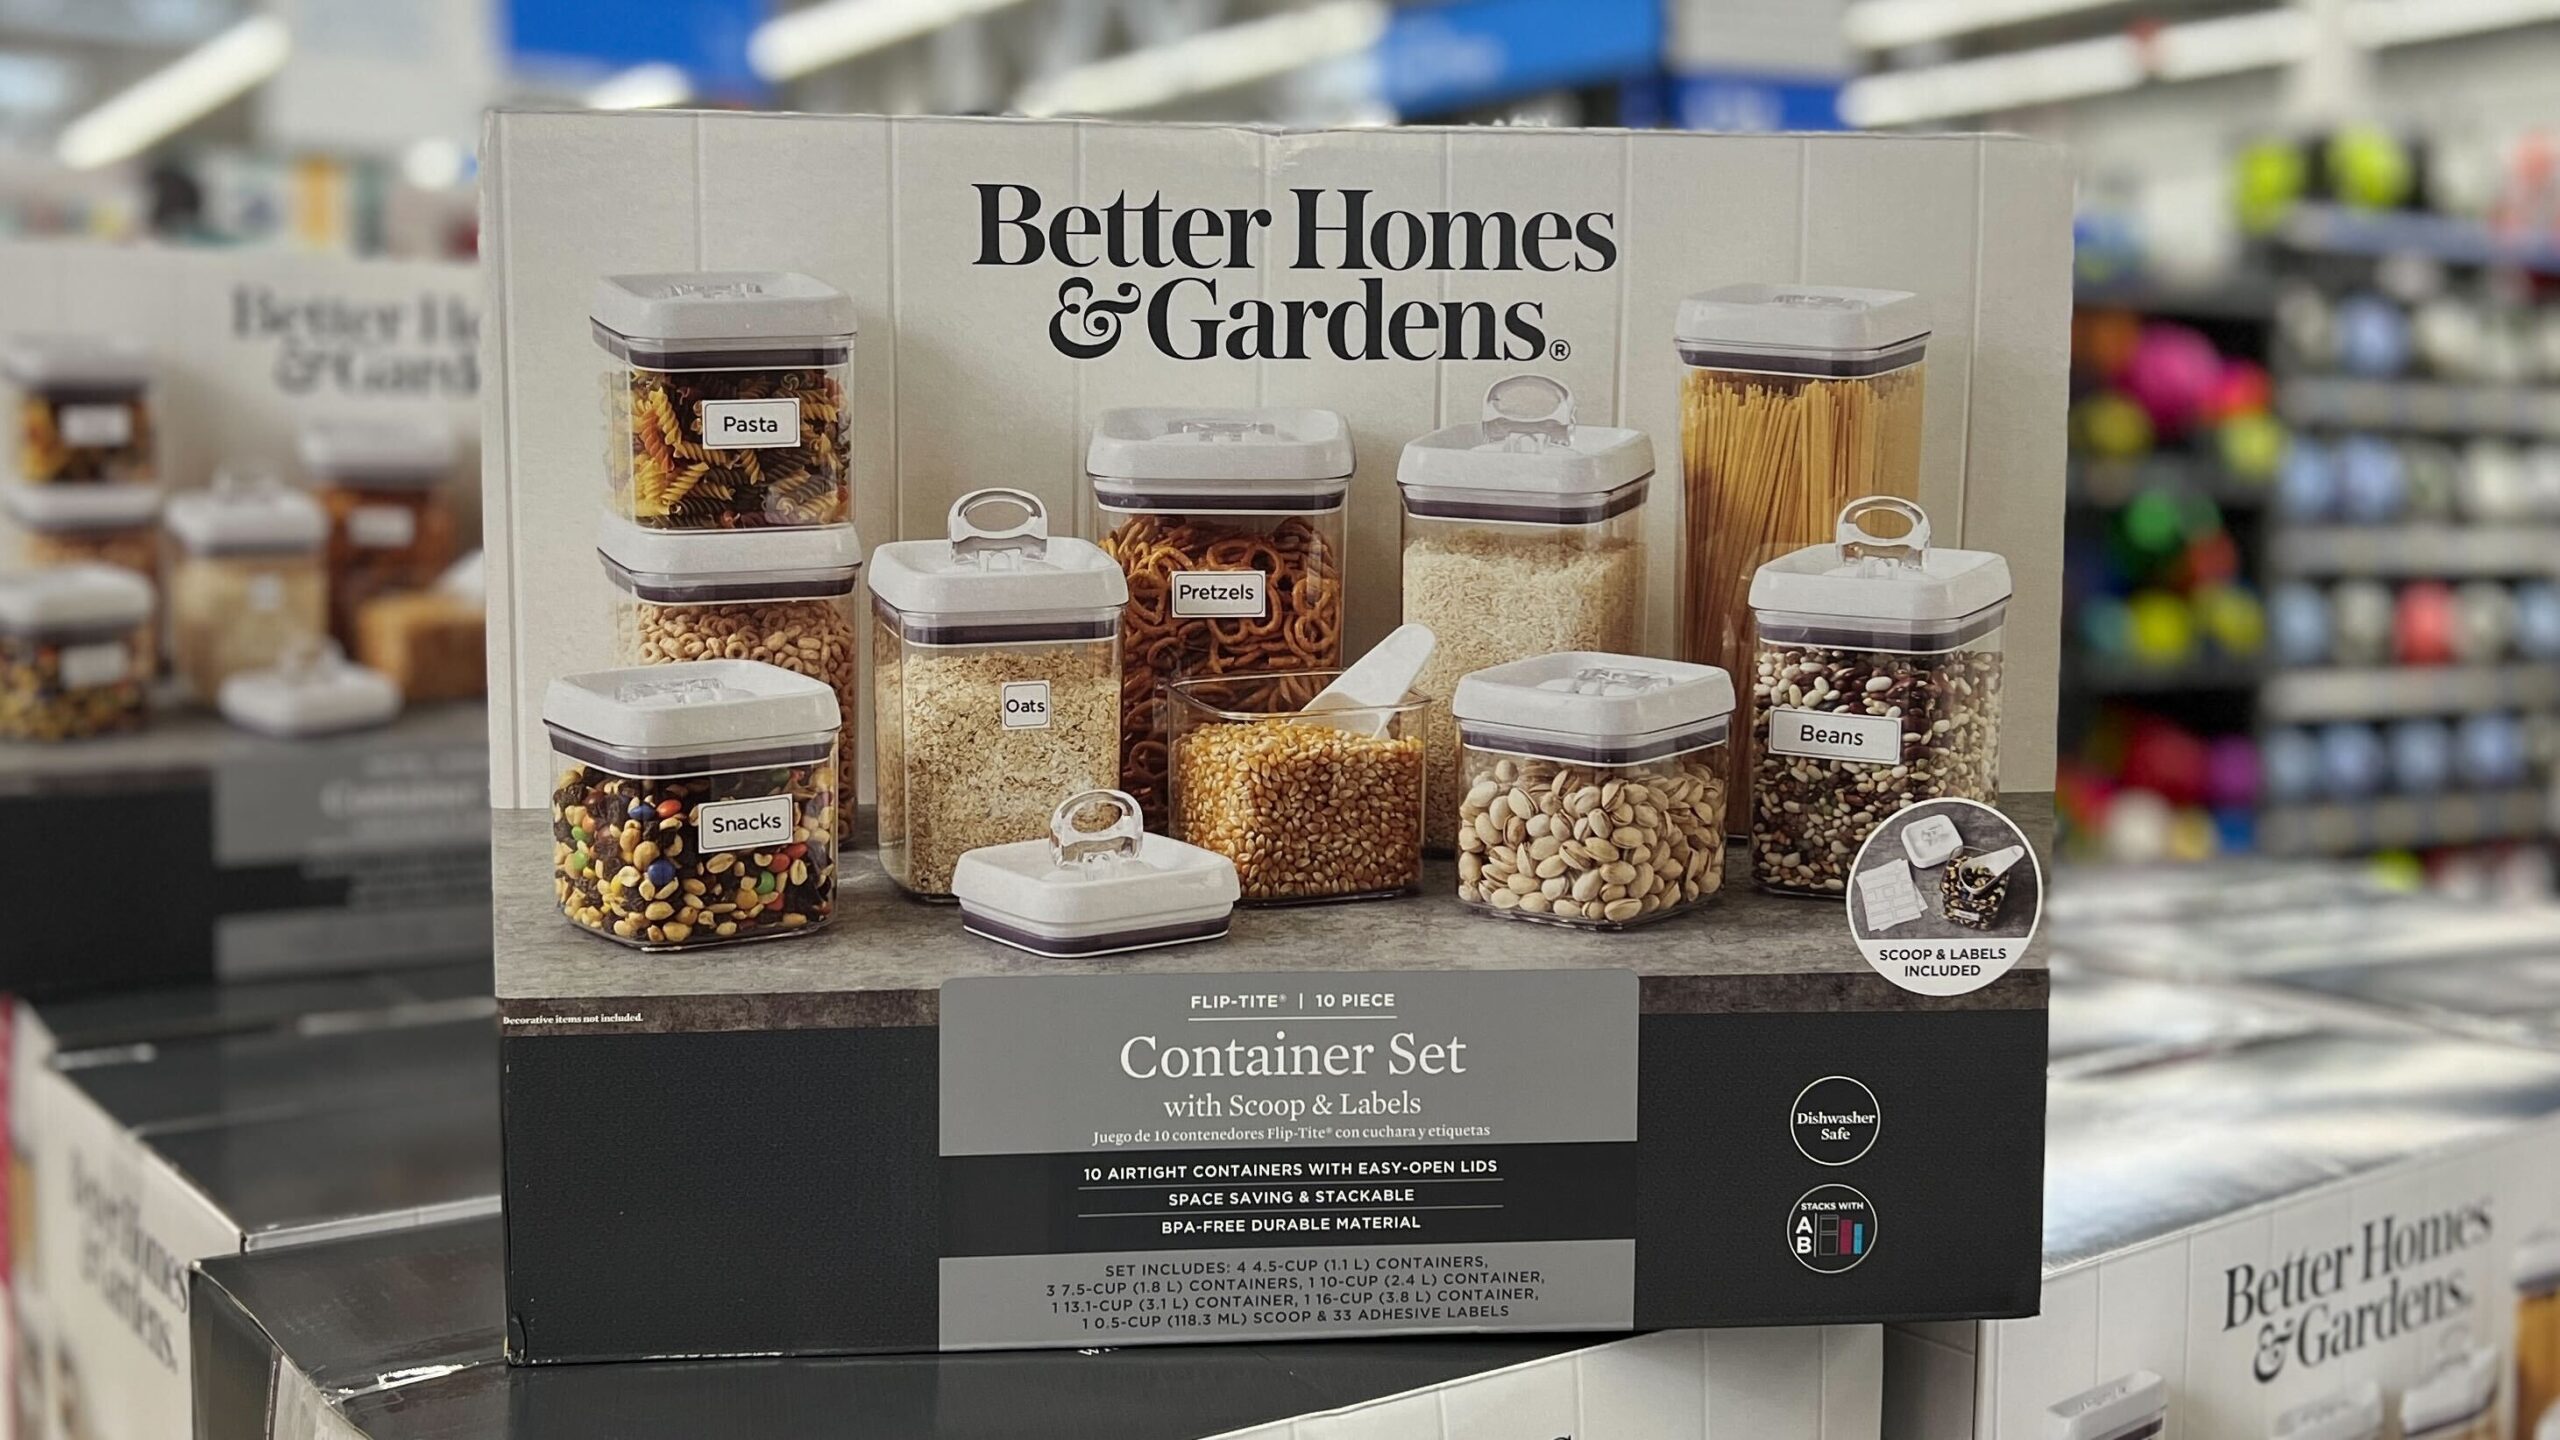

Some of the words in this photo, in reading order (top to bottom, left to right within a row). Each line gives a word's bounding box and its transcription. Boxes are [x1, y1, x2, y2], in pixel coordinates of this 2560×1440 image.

[971, 183, 1272, 269] Better
[1289, 188, 1617, 272] Homes
[723, 416, 778, 433] Pasta
[1180, 584, 1254, 600] Pretzels
[1006, 699, 1045, 713] Oats
[1800, 724, 1864, 746] Beans
[712, 813, 782, 834] Snacks
[1879, 949, 1932, 961] SCOOP
[1936, 949, 1945, 960] &
[1950, 948, 2007, 959] LABELS
[1904, 965, 1981, 977] INCLUDED
[1315, 994, 1335, 1008] 10
[1342, 993, 1395, 1007] PIECE
[503, 1015, 554, 1025] Decorative
[555, 1014, 582, 1024] items
[583, 1015, 599, 1024] not
[600, 1013, 644, 1023] included.
[1120, 1030, 1375, 1079] Container
[1389, 1032, 1467, 1075] Set
[1164, 1093, 1222, 1118] with
[1229, 1094, 1306, 1122] Scoop
[1312, 1094, 1333, 1115] &
[1339, 1090, 1422, 1115] Labels
[1797, 1111, 1876, 1125] Dishwasher
[1092, 1131, 1132, 1147] Juego
[1134, 1129, 1151, 1143] de
[1154, 1130, 1170, 1142] 10
[1172, 1127, 1265, 1142] contenedores
[1335, 1128, 1360, 1139] con
[1362, 1125, 1416, 1138] cuchara
[1417, 1127, 1427, 1140] y
[1428, 1124, 1491, 1140] etiquetas
[1821, 1127, 1851, 1140] Safe
[1084, 1168, 1102, 1181] 10
[1107, 1165, 1188, 1180] AIRTIGHT
[1193, 1163, 1303, 1178] CONTAINERS
[1308, 1162, 1352, 1176] WITH
[1358, 1161, 1455, 1174] EASY-OPEN
[1460, 1160, 1498, 1173] LIDS
[1168, 1192, 1224, 1206] SPACE
[1229, 1191, 1294, 1204] SAVING
[1299, 1190, 1309, 1203] &
[1315, 1189, 1415, 1203] STACKABLE
[1801, 1202, 1837, 1211] STACKS
[1838, 1202, 1864, 1210] WITH
[1161, 1220, 1246, 1234] BPA-FREE
[1251, 1217, 1331, 1232] DURABLE
[1336, 1216, 1421, 1231] MATERIAL
[1795, 1216, 1813, 1234] A
[1796, 1236, 1812, 1254] B
[1105, 1265, 1136, 1277] SET
[1142, 1262, 1231, 1276] INCLUDES:
[1236, 1261, 1246, 1273] 4
[1252, 1259, 1318, 1273] 4.5-CUP
[1323, 1259, 1348, 1273] (1.1
[1354, 1258, 1370, 1271] L)
[1376, 1256, 1489, 1269] CONTAINERS,
[2223, 1245, 2353, 1332] Better
[2359, 1198, 2493, 1283] Homes
[1046, 1285, 1055, 1296] 3
[1062, 1283, 1127, 1296] 7.5-CUP
[1132, 1281, 1161, 1295] (1.8
[1167, 1280, 1183, 1293] L)
[1189, 1277, 1303, 1291] CONTAINERS,
[1320, 1275, 1378, 1288] 10-CUP
[1384, 1274, 1415, 1288] (2.4
[1421, 1273, 1437, 1287] L)
[1443, 1271, 1545, 1285] CONTAINER,
[1064, 1299, 1133, 1313] 13.1-CUP
[1138, 1298, 1166, 1312] (3.1
[1172, 1297, 1189, 1310] L)
[1195, 1294, 1298, 1309] CONTAINER,
[1317, 1292, 1373, 1305] 16-CUP
[1379, 1291, 1409, 1305] (3.8
[1416, 1290, 1431, 1304] L)
[1437, 1288, 1539, 1301] CONTAINER,
[1094, 1316, 1161, 1329] 0.5-CUP
[1167, 1314, 1211, 1328] (118.3
[1217, 1312, 1247, 1327] ML)
[1253, 1310, 1311, 1325] SCOOP
[1317, 1310, 1327, 1322] &
[1333, 1309, 1352, 1321] 33
[1358, 1307, 1441, 1320] ADHESIVE
[1447, 1305, 1510, 1318] LABELS
